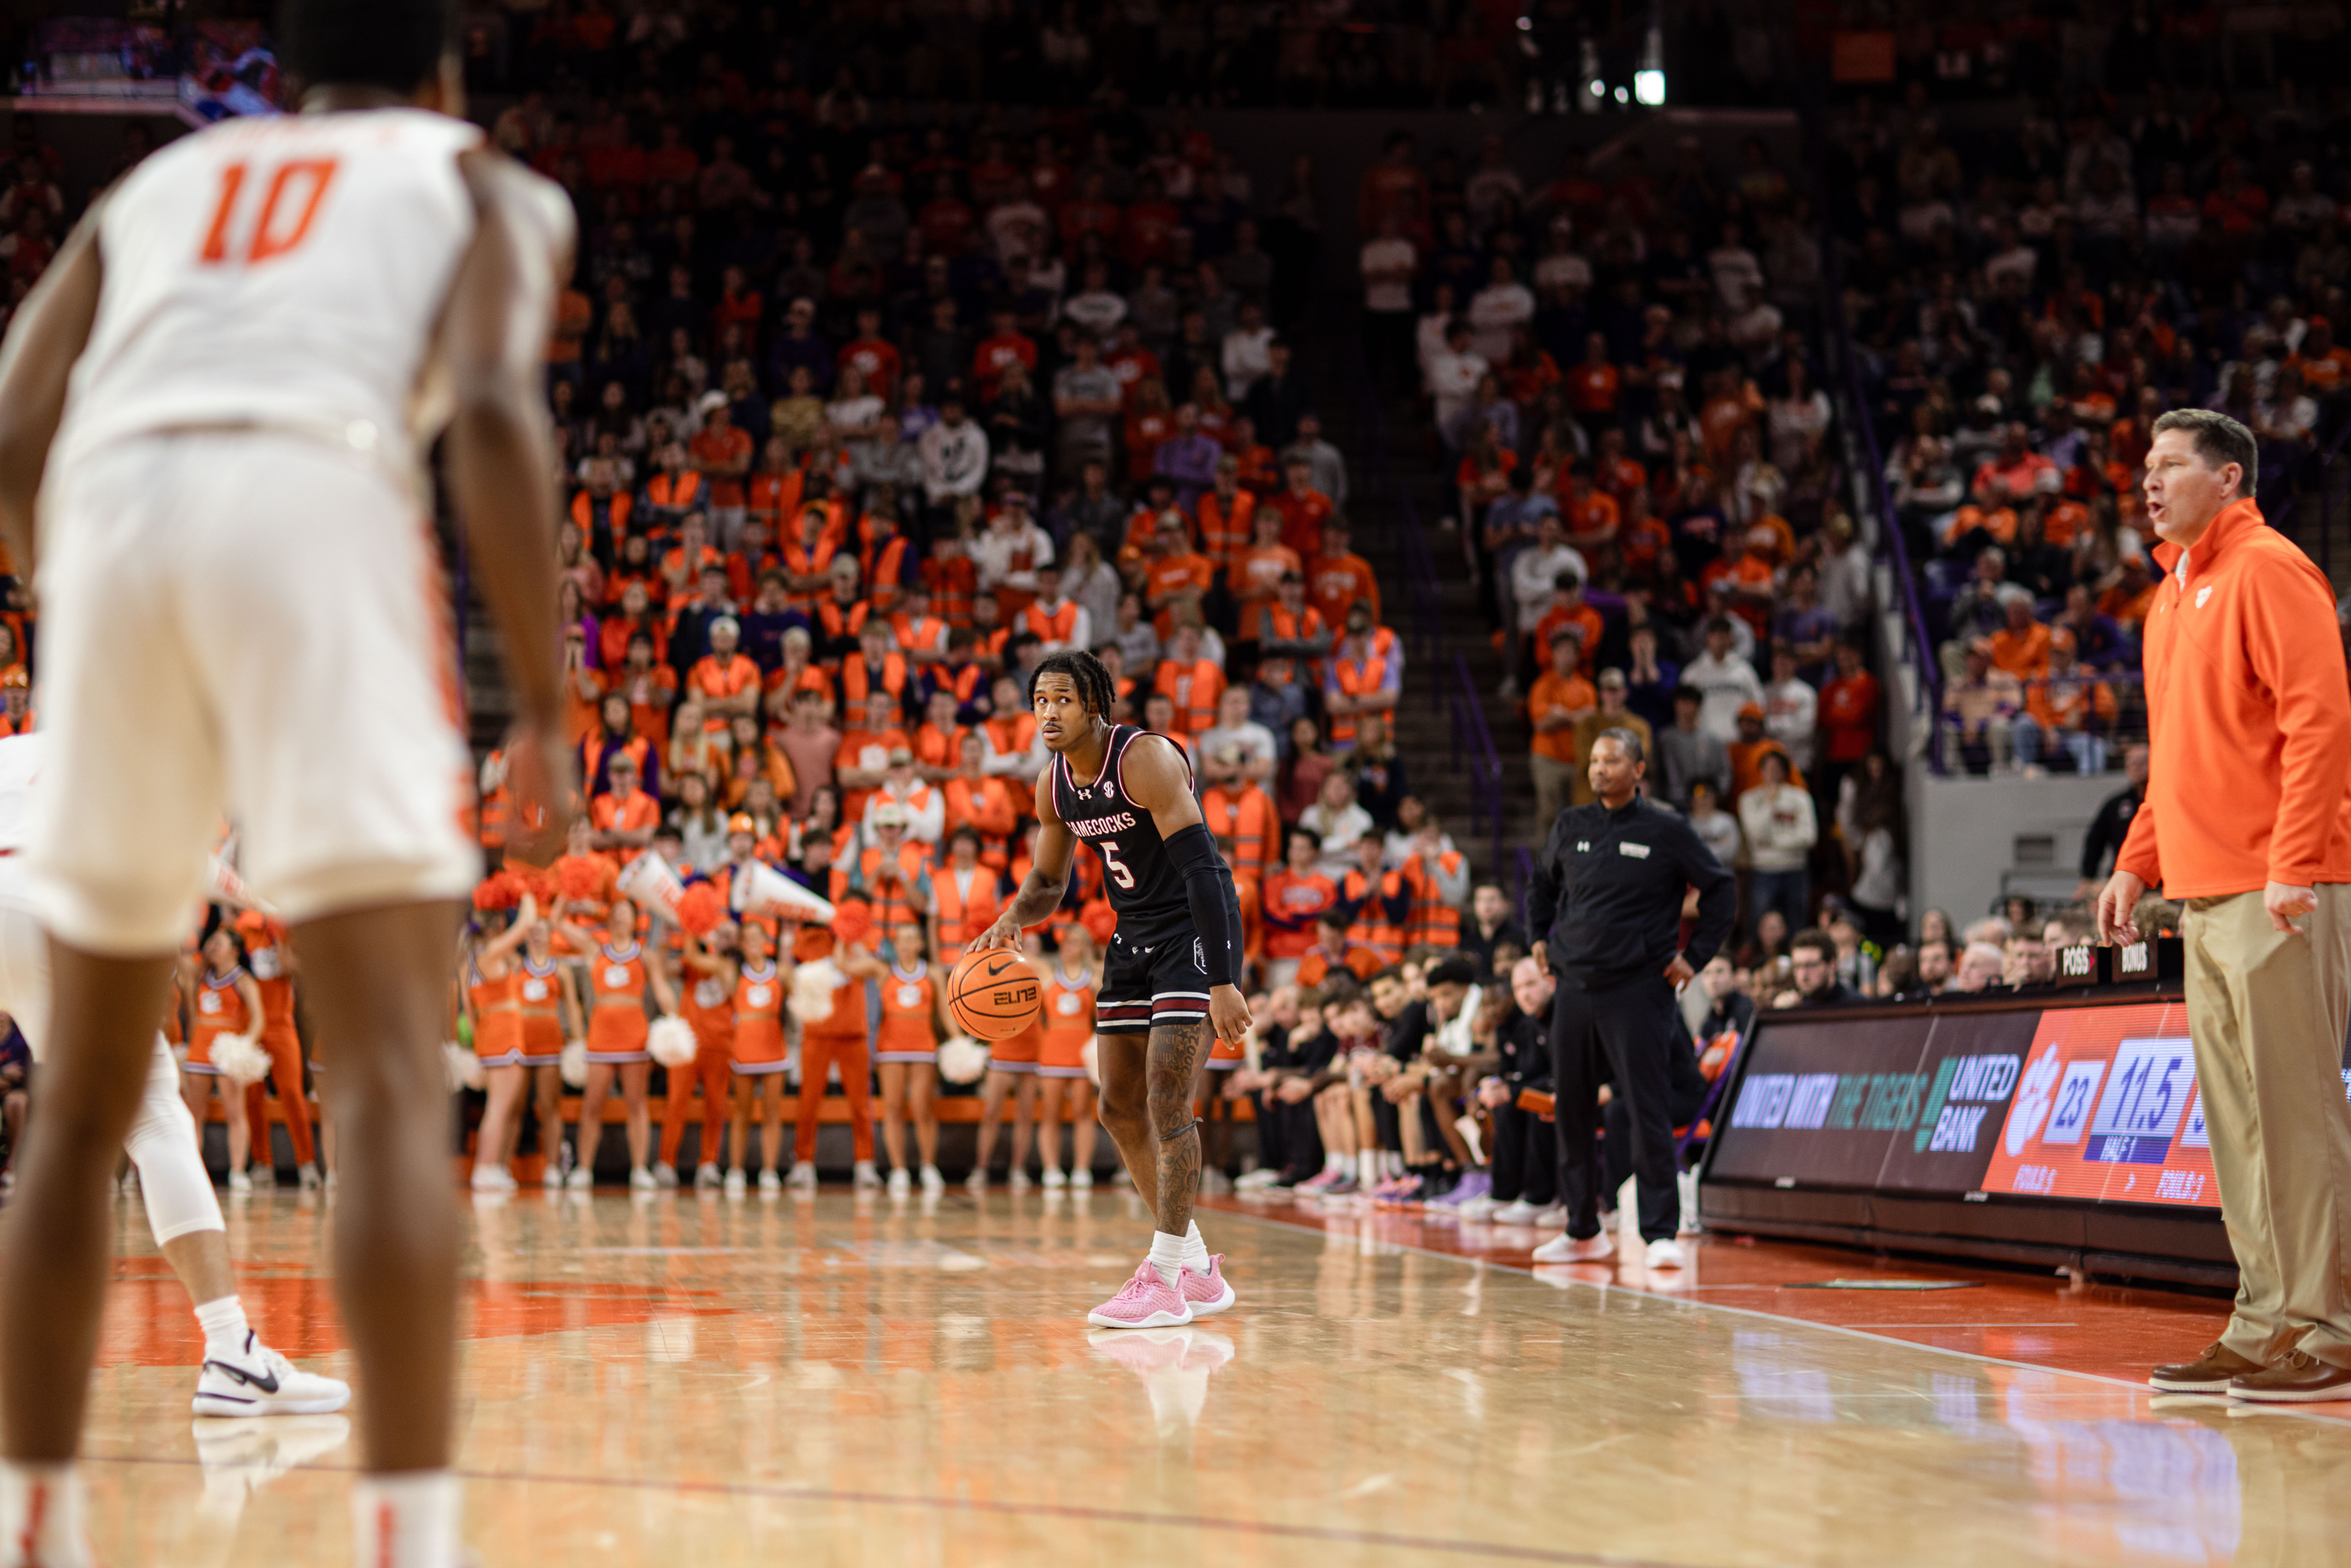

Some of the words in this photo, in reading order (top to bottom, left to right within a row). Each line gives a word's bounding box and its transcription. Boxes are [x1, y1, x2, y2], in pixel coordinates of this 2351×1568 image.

[197, 153, 340, 268] 10
[1098, 840, 1136, 890] 5
[2063, 945, 2090, 976] POSS
[2121, 941, 2148, 973] BONUS
[1731, 1073, 1797, 1129] UNITED
[1949, 1054, 2021, 1101] UNITED
[2054, 1075, 2090, 1129] 23
[2110, 1056, 2183, 1131] 11.5
[1928, 1105, 1988, 1152] BANK
